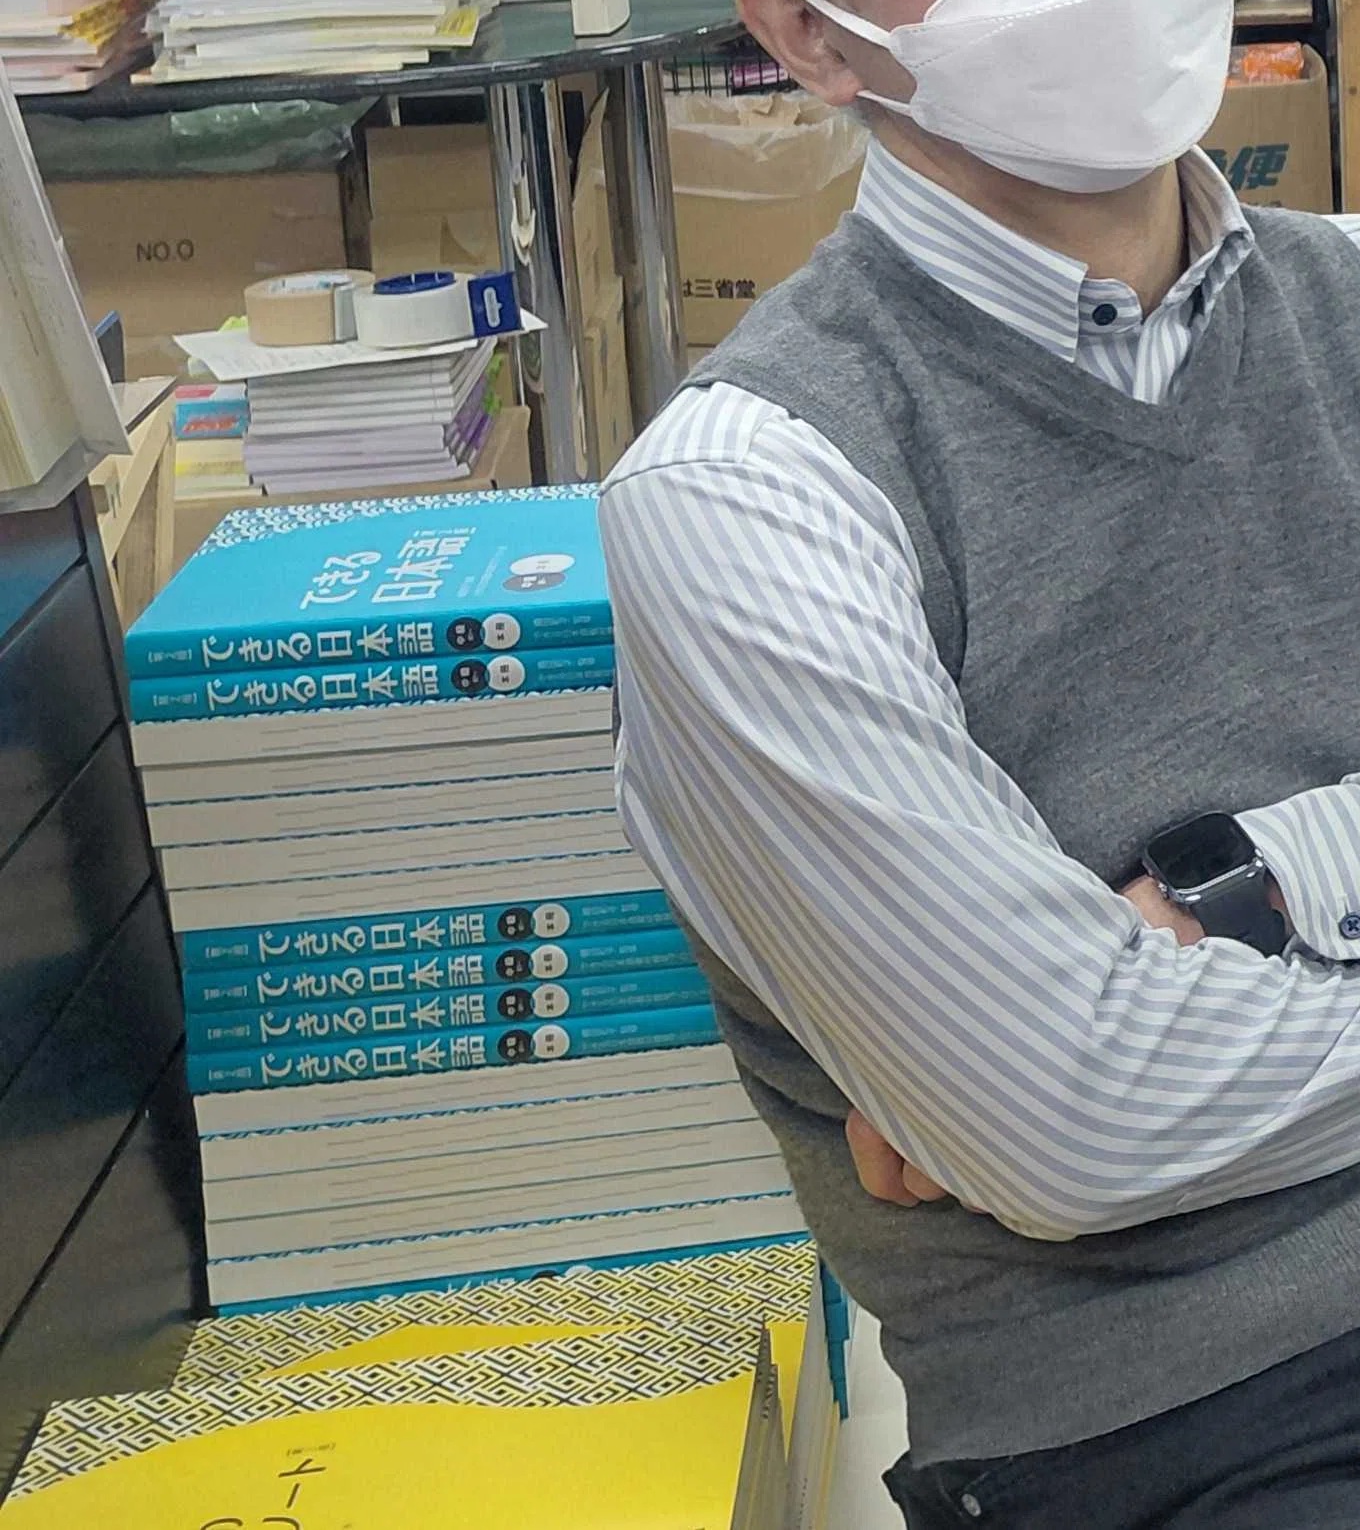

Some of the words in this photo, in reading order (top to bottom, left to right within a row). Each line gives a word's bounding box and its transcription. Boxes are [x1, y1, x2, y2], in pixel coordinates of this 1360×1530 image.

[300, 550, 382, 611] できる
[371, 533, 471, 605] 日本語
[202, 620, 436, 670] できる日本語
[206, 663, 440, 712] できる日本語
[257, 912, 487, 962] できる日本語
[256, 953, 486, 1003] できる日本語
[258, 994, 487, 1045] できる日本語
[259, 1034, 487, 1085] できる日本語
